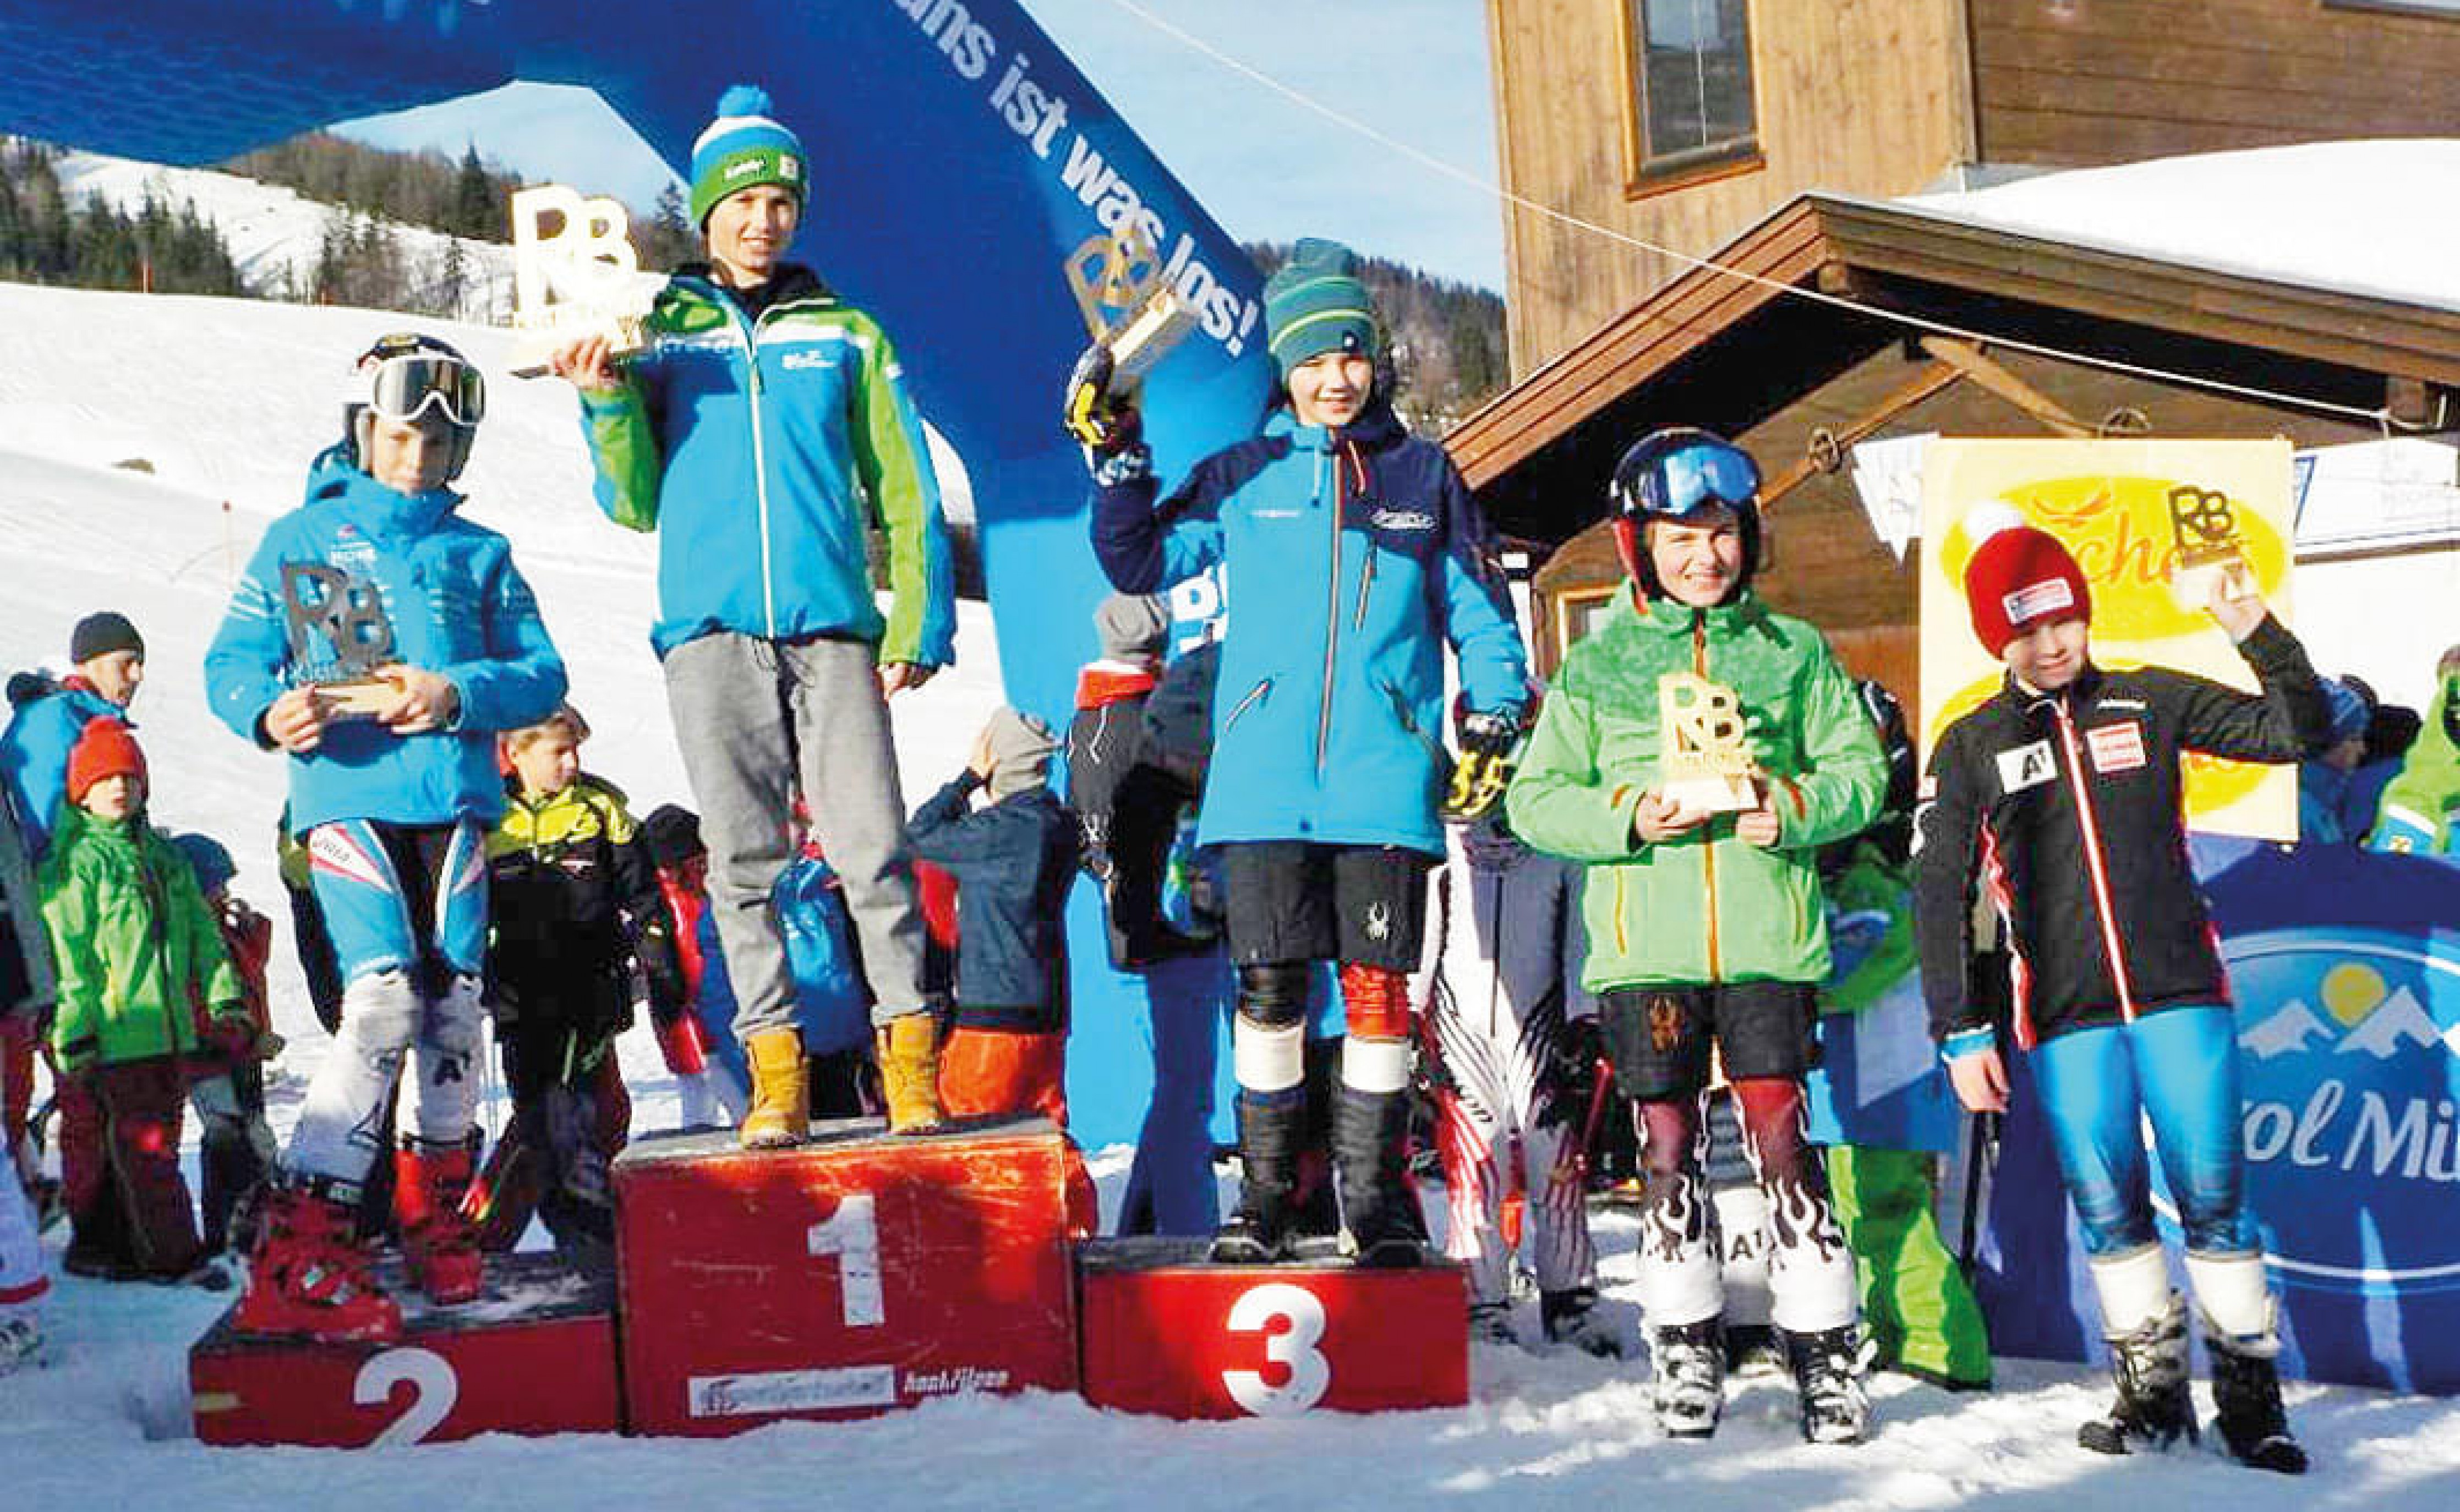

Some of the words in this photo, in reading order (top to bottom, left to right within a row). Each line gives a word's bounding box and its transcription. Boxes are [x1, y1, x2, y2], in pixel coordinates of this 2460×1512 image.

[990, 53, 1068, 159] ist
[1061, 134, 1166, 249] was
[1160, 233, 1259, 358] los!
[2242, 1077, 2346, 1166] ol
[807, 1193, 885, 1326] 1
[354, 1347, 458, 1450] 2
[1221, 1283, 1332, 1418] 3
